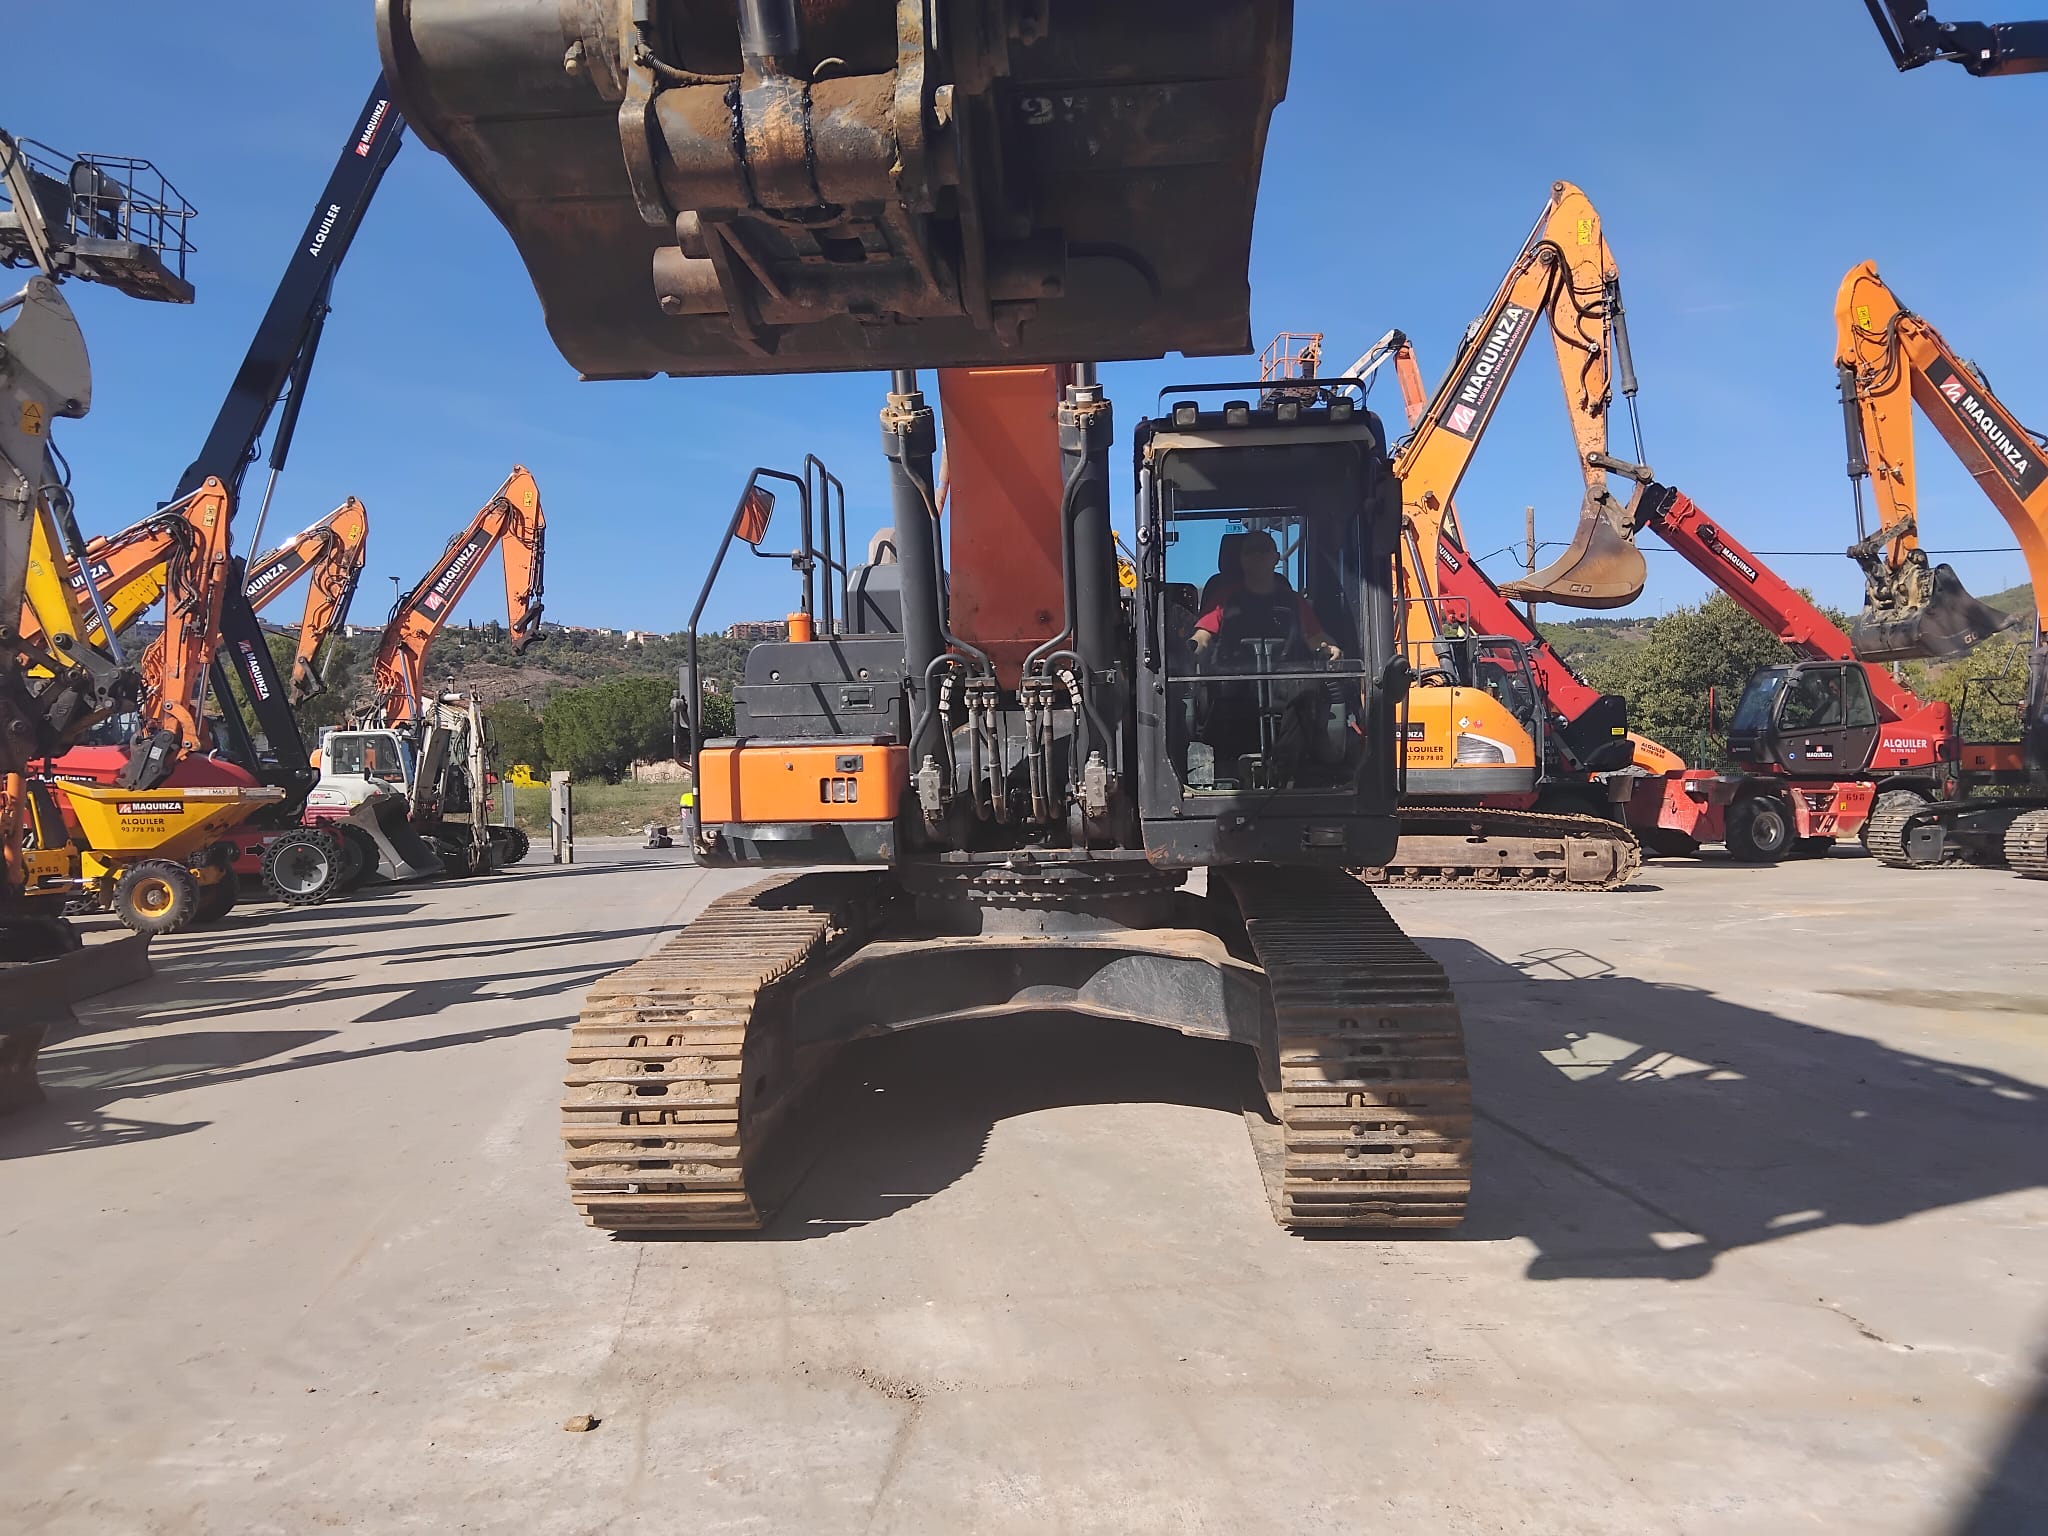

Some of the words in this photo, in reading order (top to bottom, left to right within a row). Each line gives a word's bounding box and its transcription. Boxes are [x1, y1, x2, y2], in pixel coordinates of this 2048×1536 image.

[361, 99, 388, 143] MAQUINZA
[309, 204, 341, 257] ALQUILER
[1460, 307, 1523, 404] MAQUINZA
[1962, 395, 2029, 475] MAQUINZA
[435, 542, 478, 594] MAQUINZA
[1440, 545, 1459, 570] UINZA
[1722, 547, 1756, 579] MAQUINZA
[246, 563, 288, 597] QUINZA
[246, 652, 270, 700] MAQUINZA
[1883, 738, 1927, 748] ALQUILER
[132, 803, 181, 811] MAQUINZA
